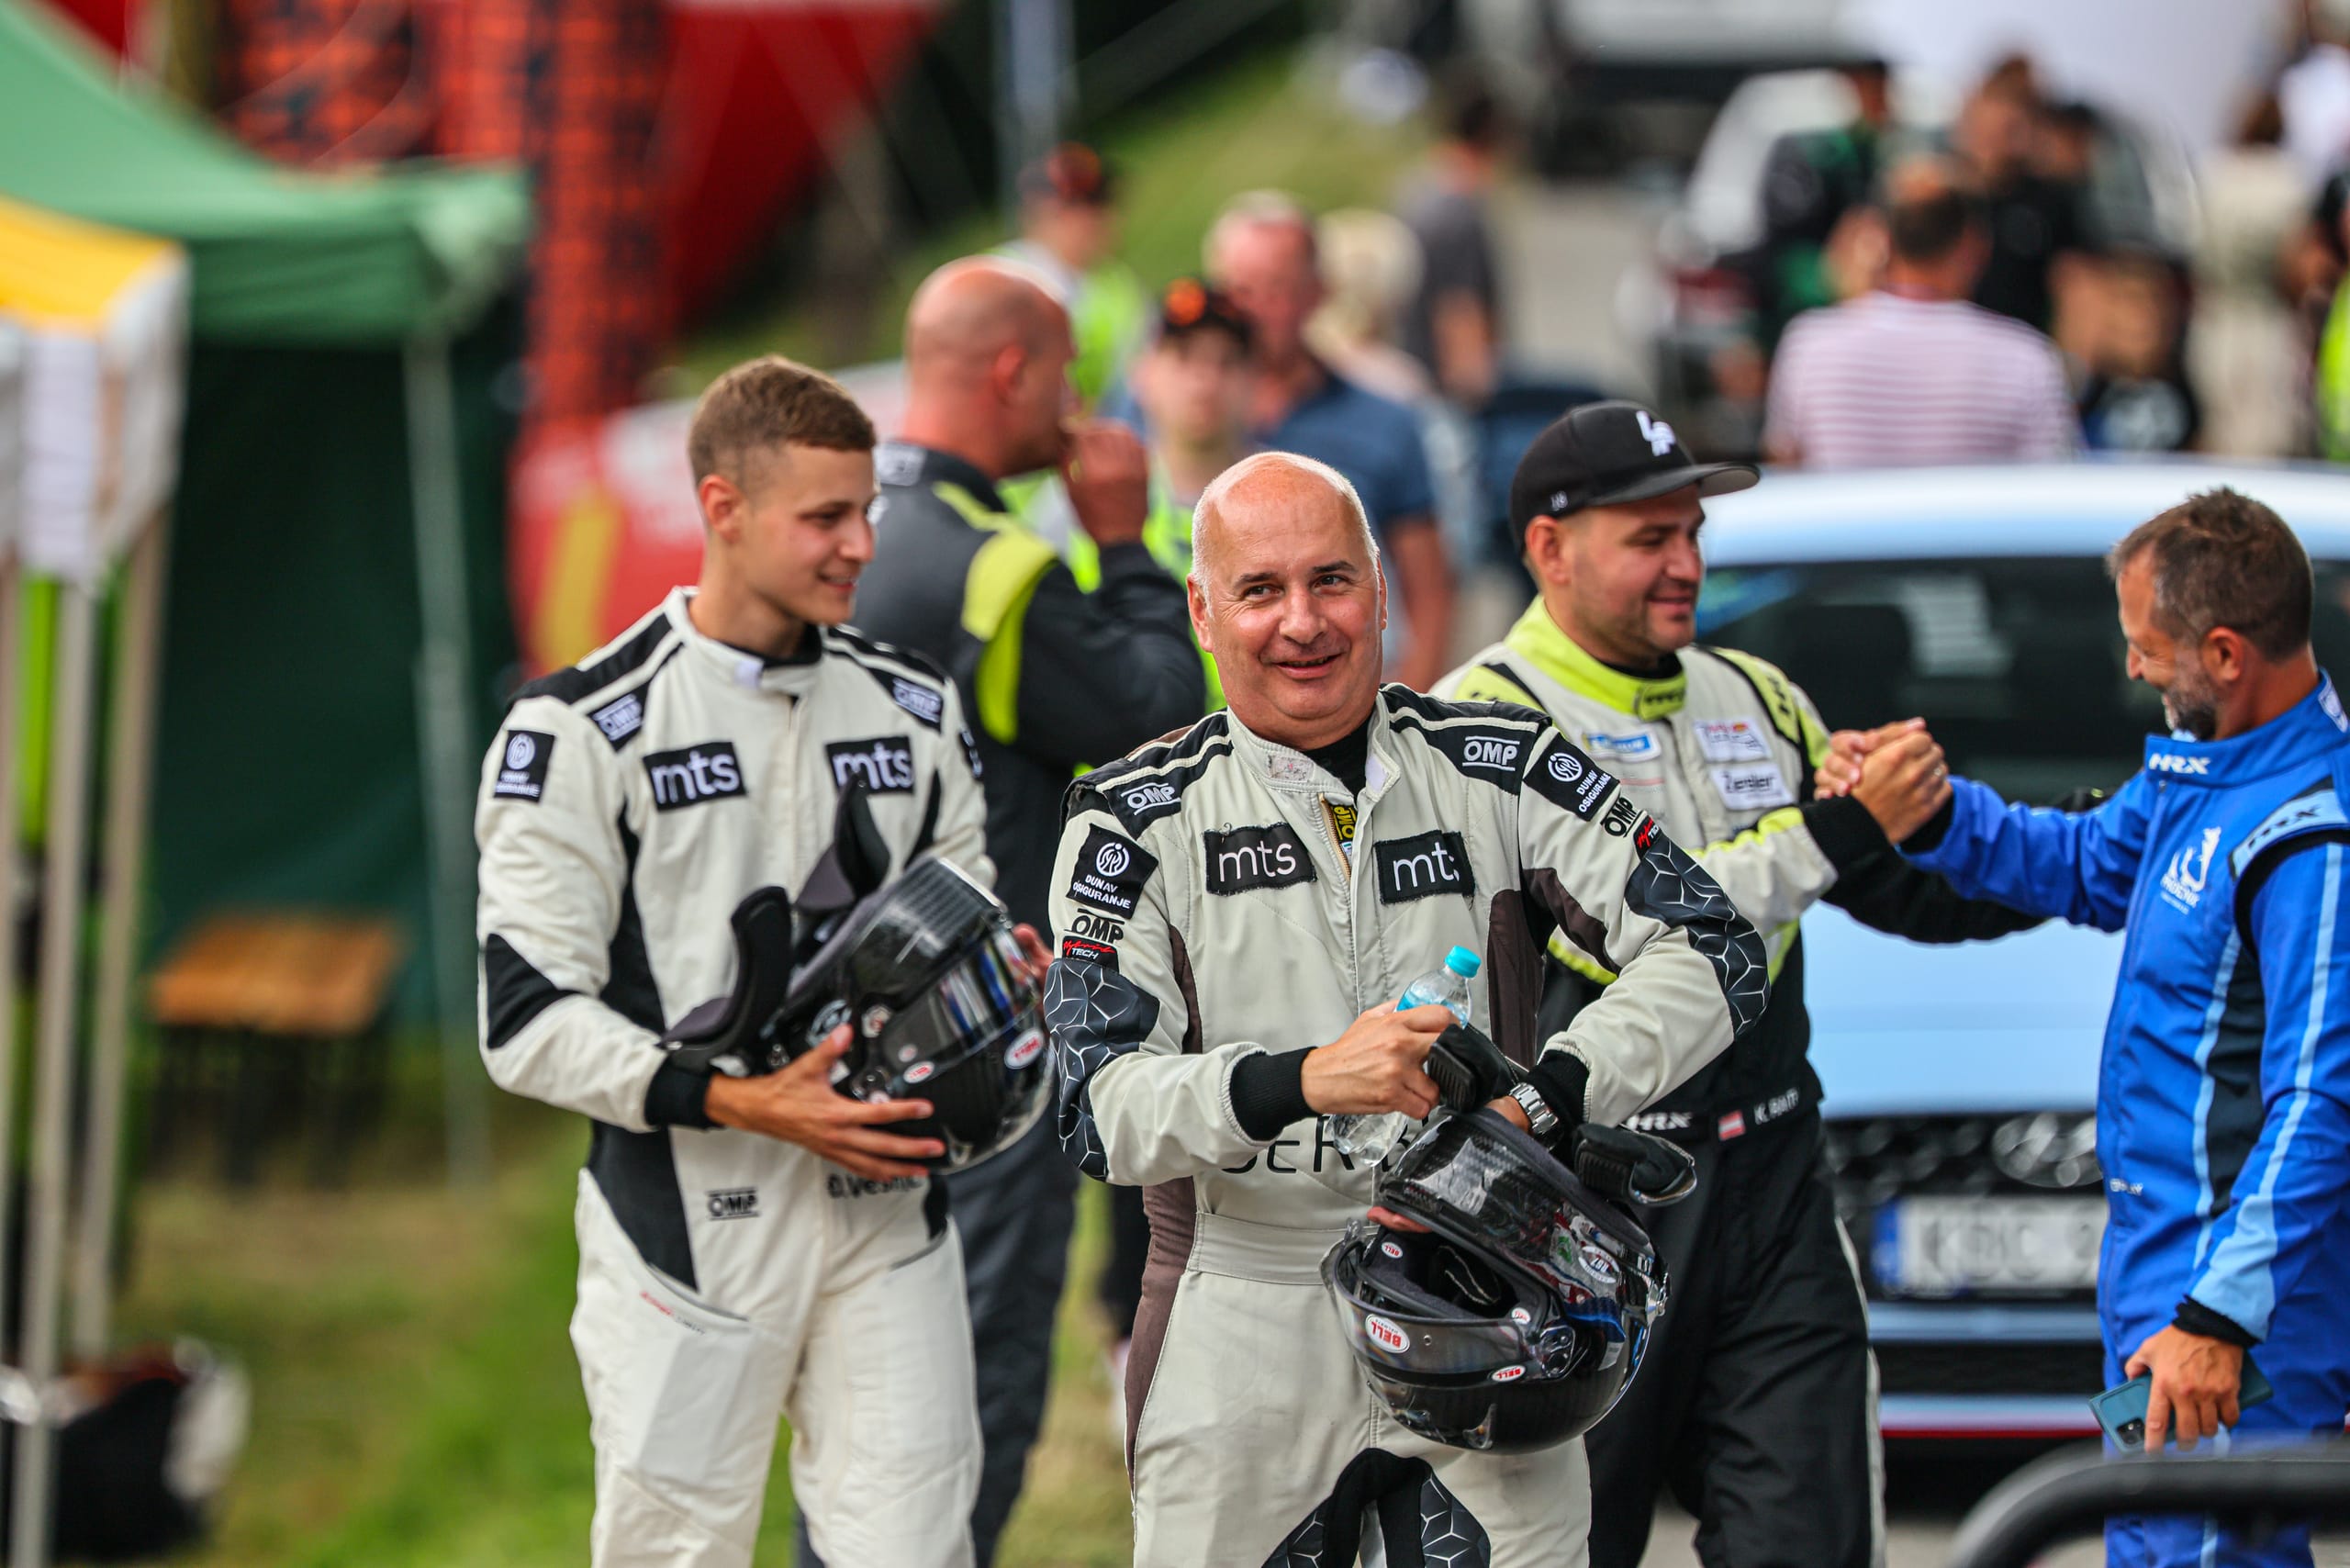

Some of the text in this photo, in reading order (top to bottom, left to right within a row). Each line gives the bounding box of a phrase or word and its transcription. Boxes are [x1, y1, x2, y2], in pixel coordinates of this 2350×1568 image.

[833, 742, 912, 789] mts
[1463, 739, 1517, 765] OMP
[651, 750, 739, 804] mts
[1127, 786, 1176, 808] OMP
[1334, 806, 1355, 838] OMP
[1604, 797, 1637, 836] OMP
[1218, 842, 1296, 882] mts
[1073, 881, 1131, 909] OSIGURANJE
[1085, 874, 1118, 893] DUNAV
[1072, 915, 1124, 944] OMP
[1072, 947, 1099, 959] TECH
[708, 1193, 758, 1215] OMP
[1371, 1320, 1402, 1348] BELL
[1496, 1368, 1521, 1380] BELL
